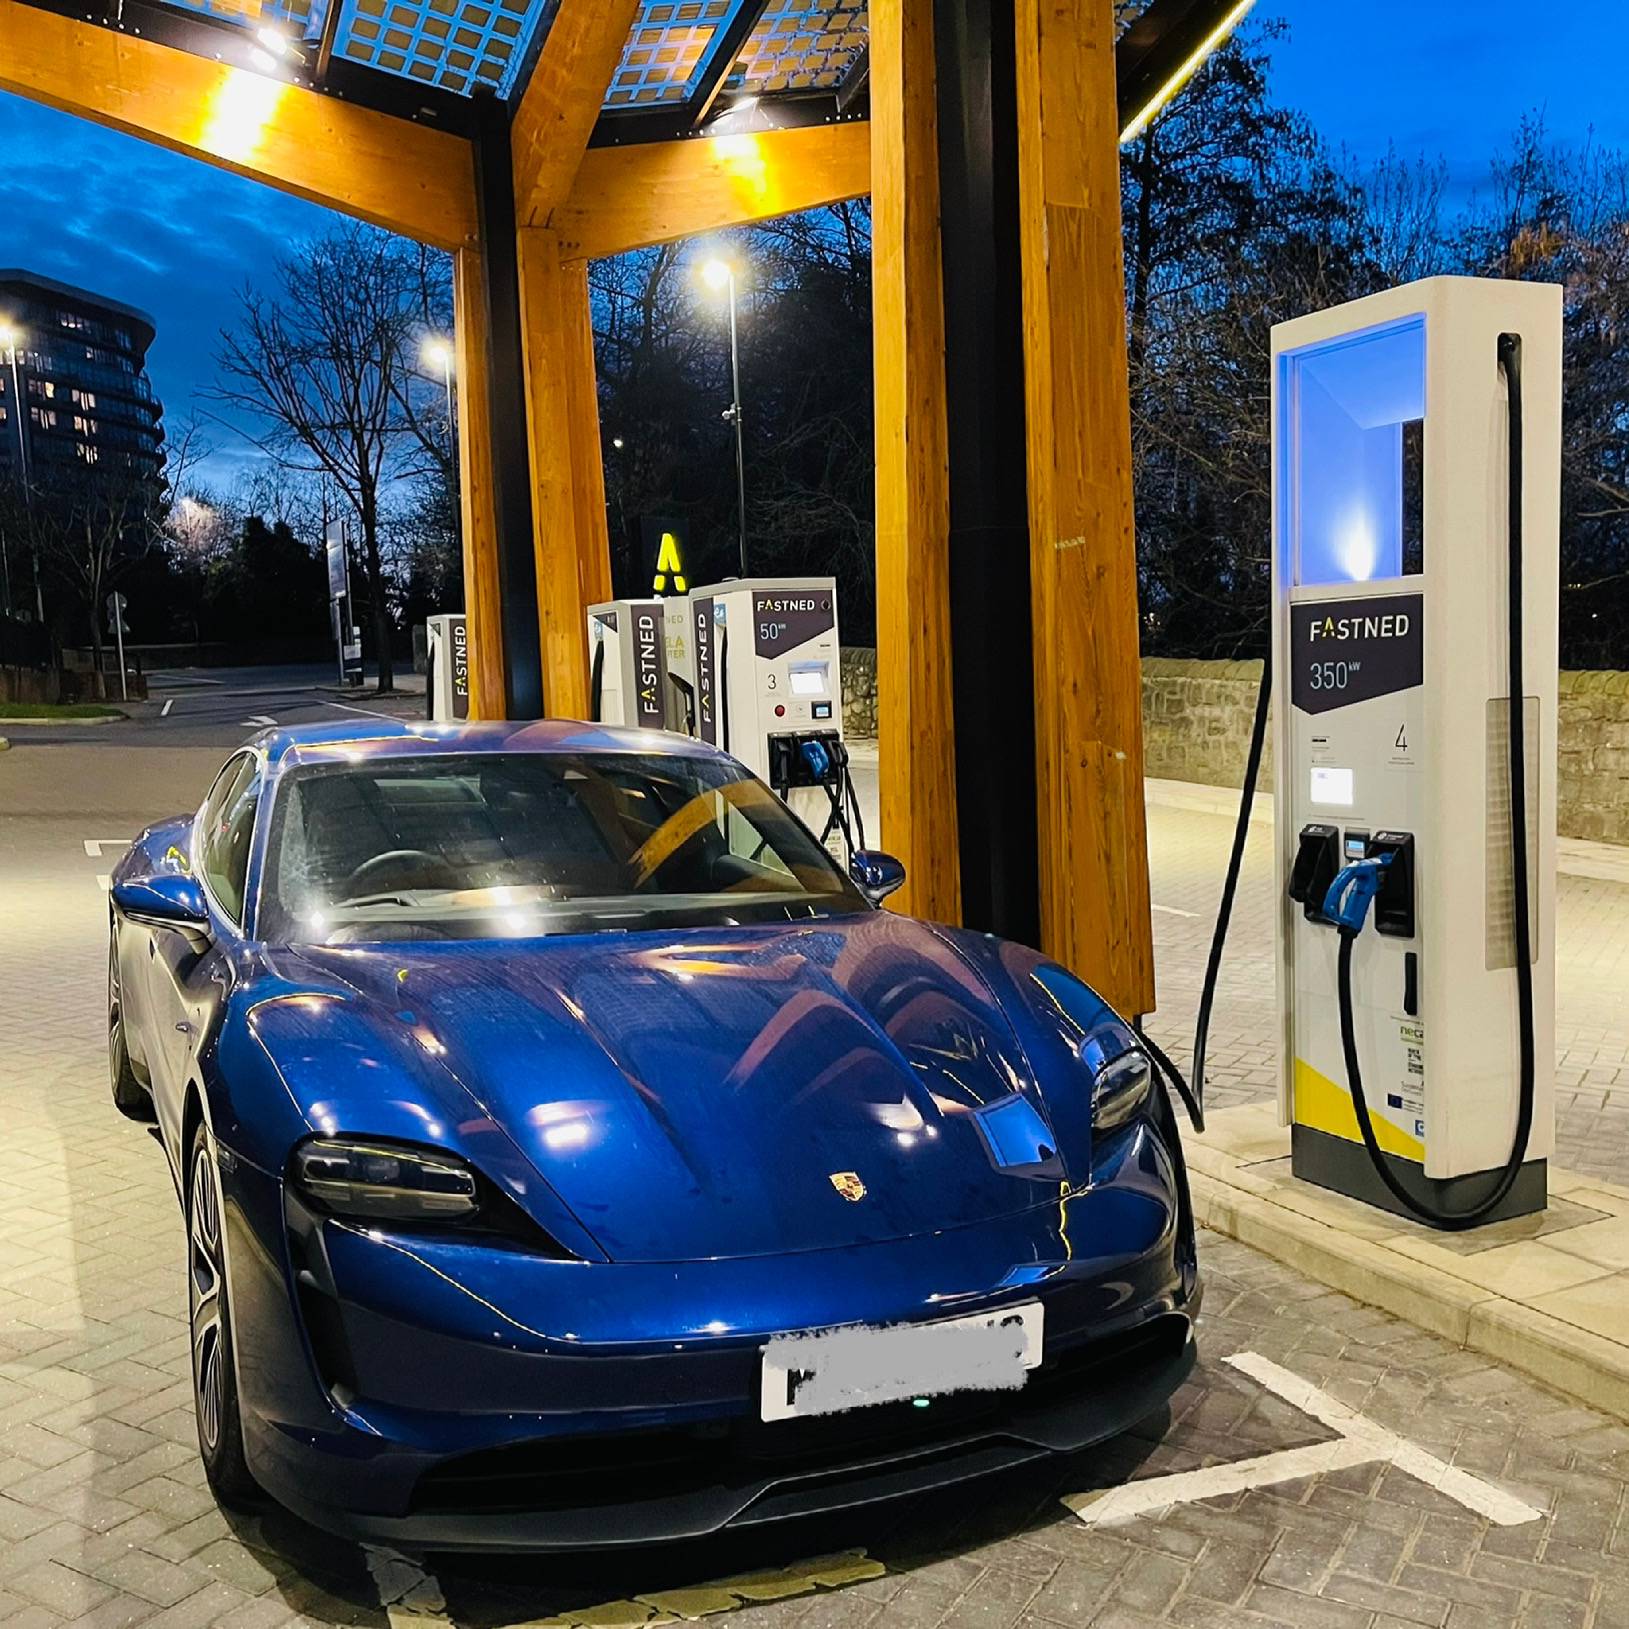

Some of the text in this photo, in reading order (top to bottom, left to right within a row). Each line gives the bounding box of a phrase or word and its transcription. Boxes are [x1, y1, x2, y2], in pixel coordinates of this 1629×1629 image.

[757, 599, 815, 612] FASTNED
[1310, 615, 1409, 642] FASTNED
[454, 626, 468, 696] FASTNED
[639, 616, 659, 713] FASTNED
[698, 613, 712, 723] FASTNED
[768, 674, 777, 689] 3
[1395, 723, 1408, 752] 4
